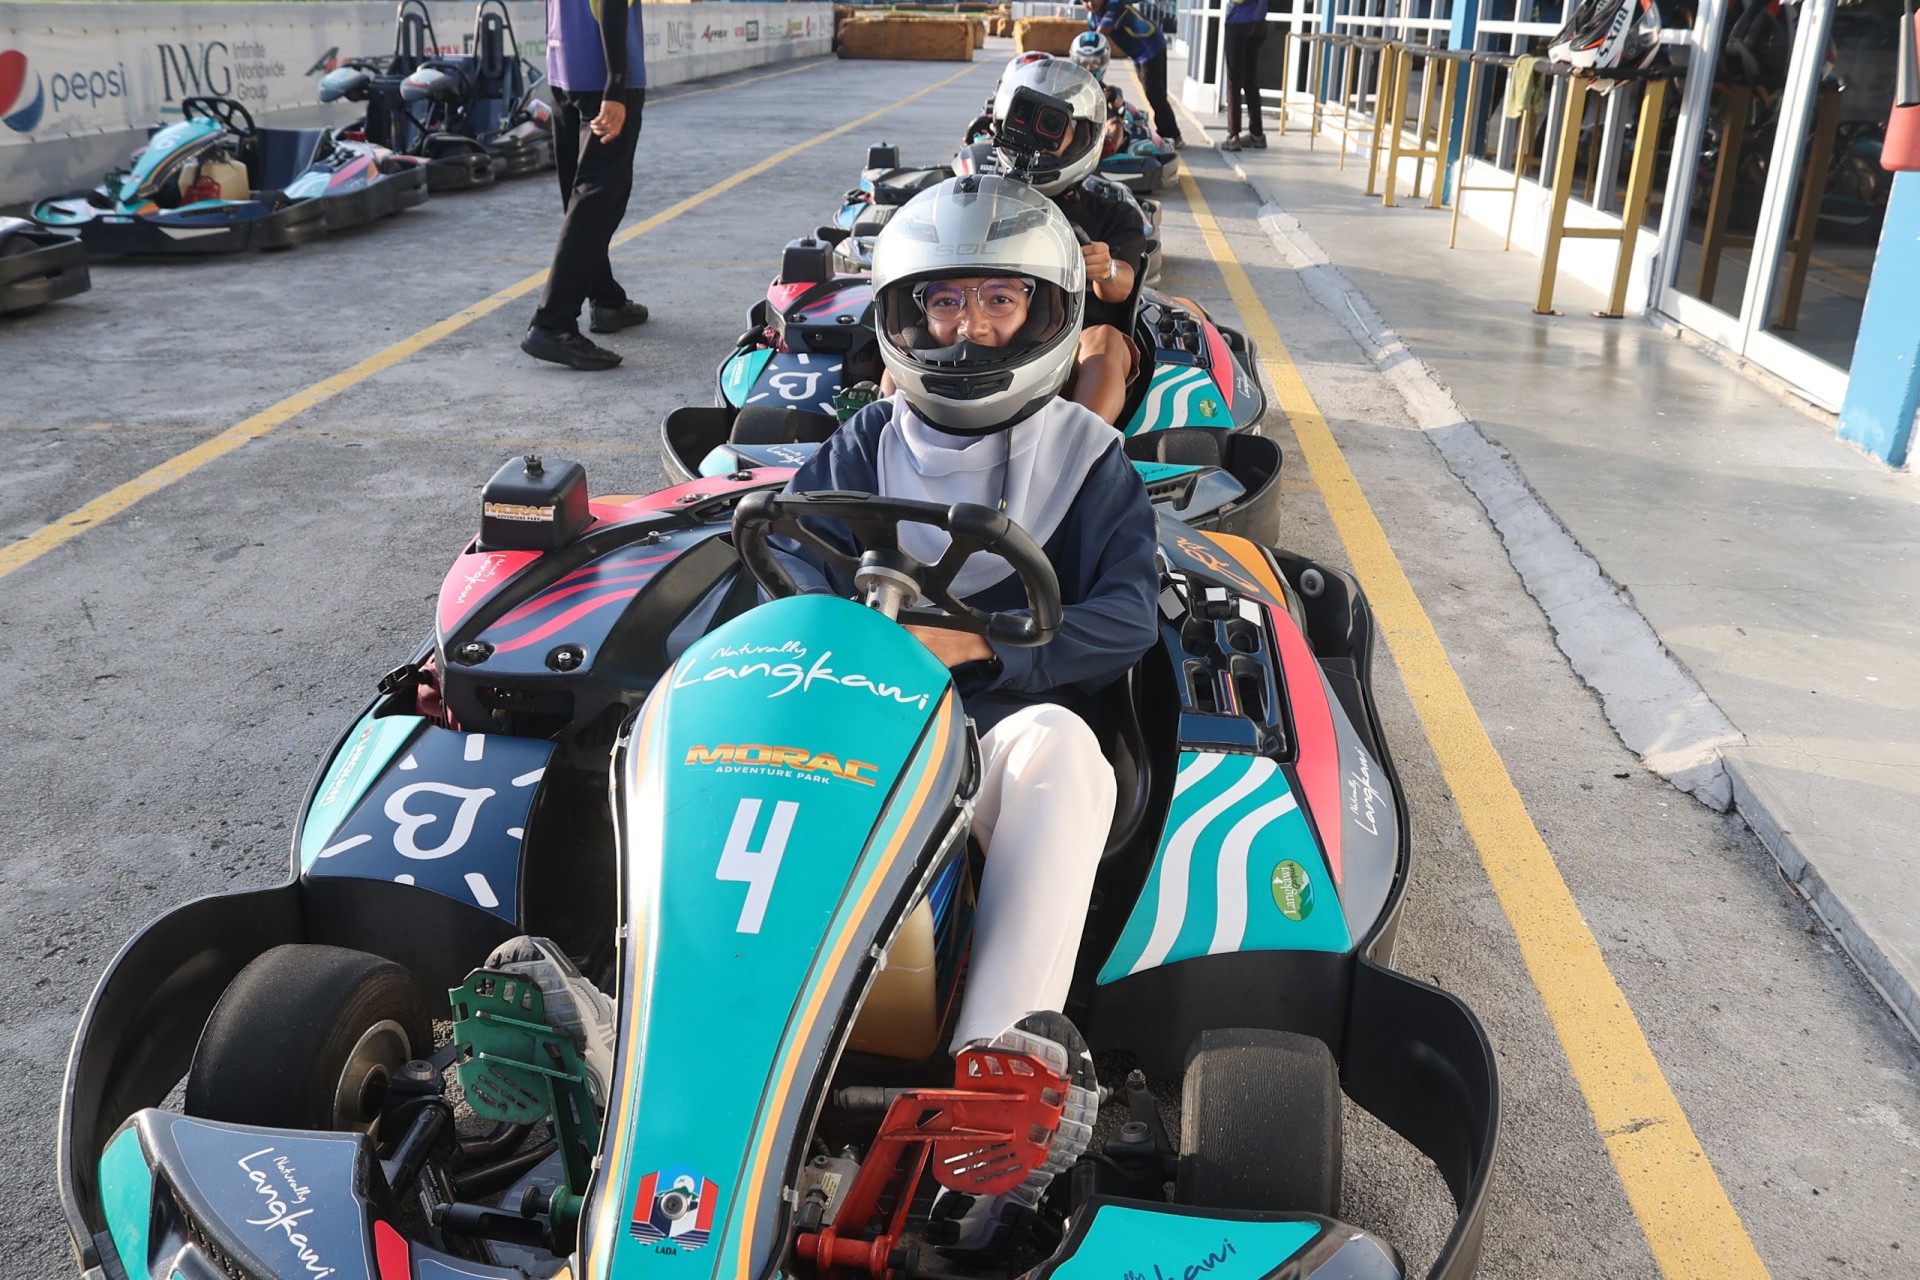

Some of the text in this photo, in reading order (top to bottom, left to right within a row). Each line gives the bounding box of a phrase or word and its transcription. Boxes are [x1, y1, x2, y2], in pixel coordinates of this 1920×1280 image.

[157, 41, 232, 102] IWG
[232, 41, 265, 59] Infinite
[233, 62, 286, 80] Worldwide
[52, 61, 128, 113] pepsi
[237, 82, 268, 102] Group
[485, 503, 554, 517] MORAC
[710, 640, 807, 660] Naturally
[673, 651, 930, 710] Langkawi
[684, 743, 879, 787] MORAC
[715, 766, 830, 785] ADVENTURE PARK
[1352, 746, 1387, 836] Langkawi
[715, 797, 800, 935] 4
[1277, 867, 1298, 915] Langkawi
[273, 1156, 311, 1204] Naturally
[237, 1147, 336, 1280] Langkawi
[655, 1246, 677, 1256] LADA
